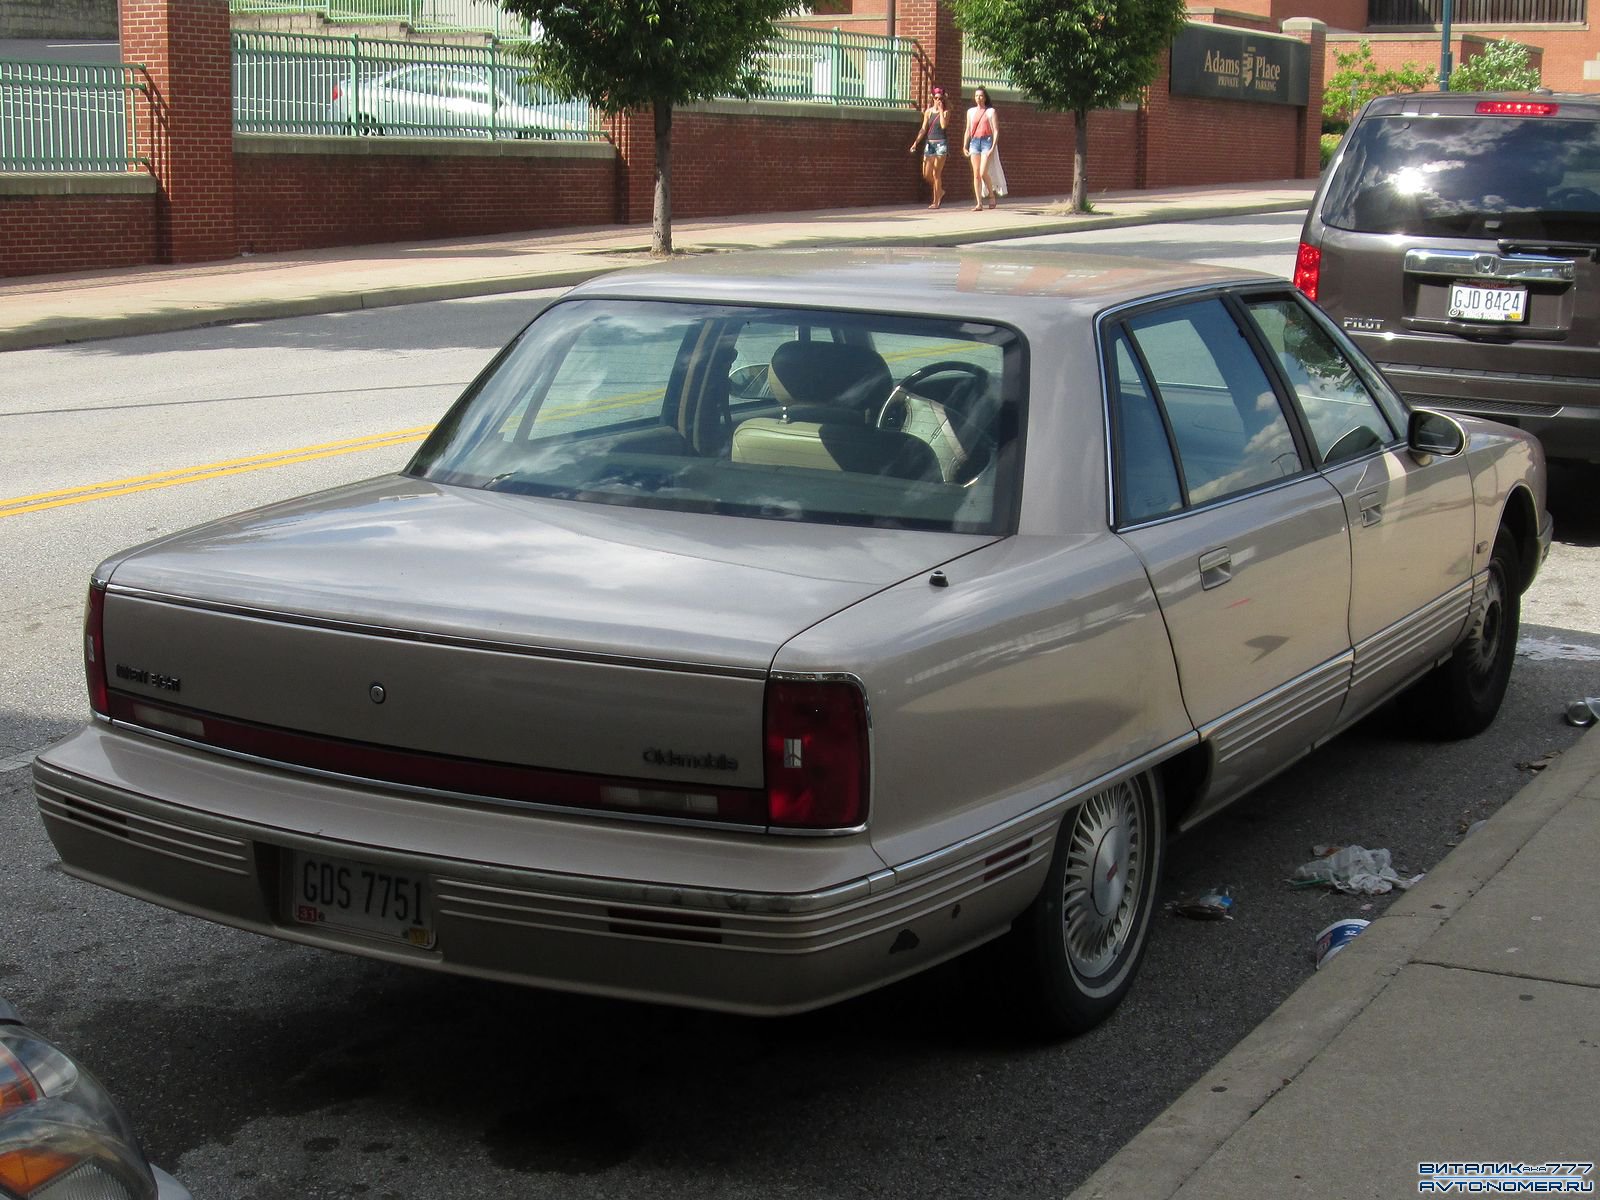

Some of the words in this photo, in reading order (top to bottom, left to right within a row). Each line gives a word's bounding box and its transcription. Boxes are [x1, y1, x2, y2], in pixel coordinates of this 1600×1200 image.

[1204, 50, 1240, 75] Adams
[1256, 56, 1280, 80] Place
[1218, 75, 1239, 88] PRIVATE
[1255, 80, 1277, 92] PARKING
[1454, 289, 1481, 309] GJD
[1485, 291, 1520, 312] 8424
[1343, 316, 1385, 330] PILOT
[303, 860, 351, 909] GDS
[361, 871, 423, 926] 7751
